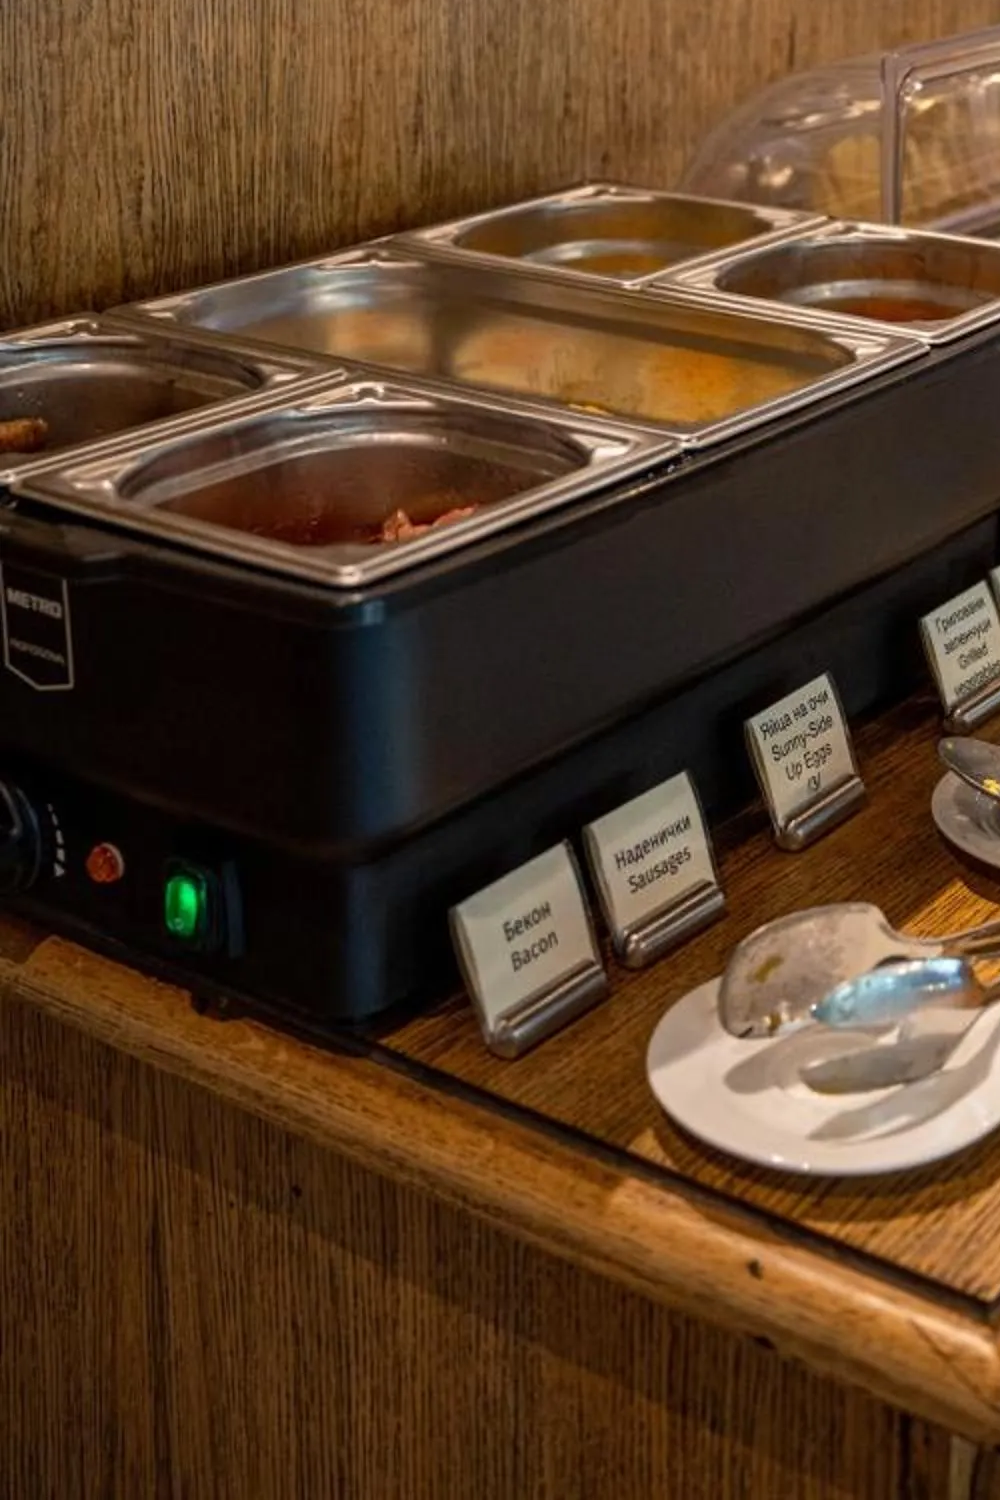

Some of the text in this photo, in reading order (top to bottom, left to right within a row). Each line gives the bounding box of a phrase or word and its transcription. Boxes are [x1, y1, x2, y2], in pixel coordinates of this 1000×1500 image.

[6, 587, 62, 619] METRO
[760, 690, 829, 740] Яйца на очи
[771, 715, 833, 762] Sunny-Side
[785, 762, 803, 781] Up
[803, 743, 833, 769] Eggs
[614, 814, 692, 870] Наденички
[627, 846, 692, 894] Sausages
[502, 901, 552, 943] Бекон
[511, 931, 559, 973] Bacon
